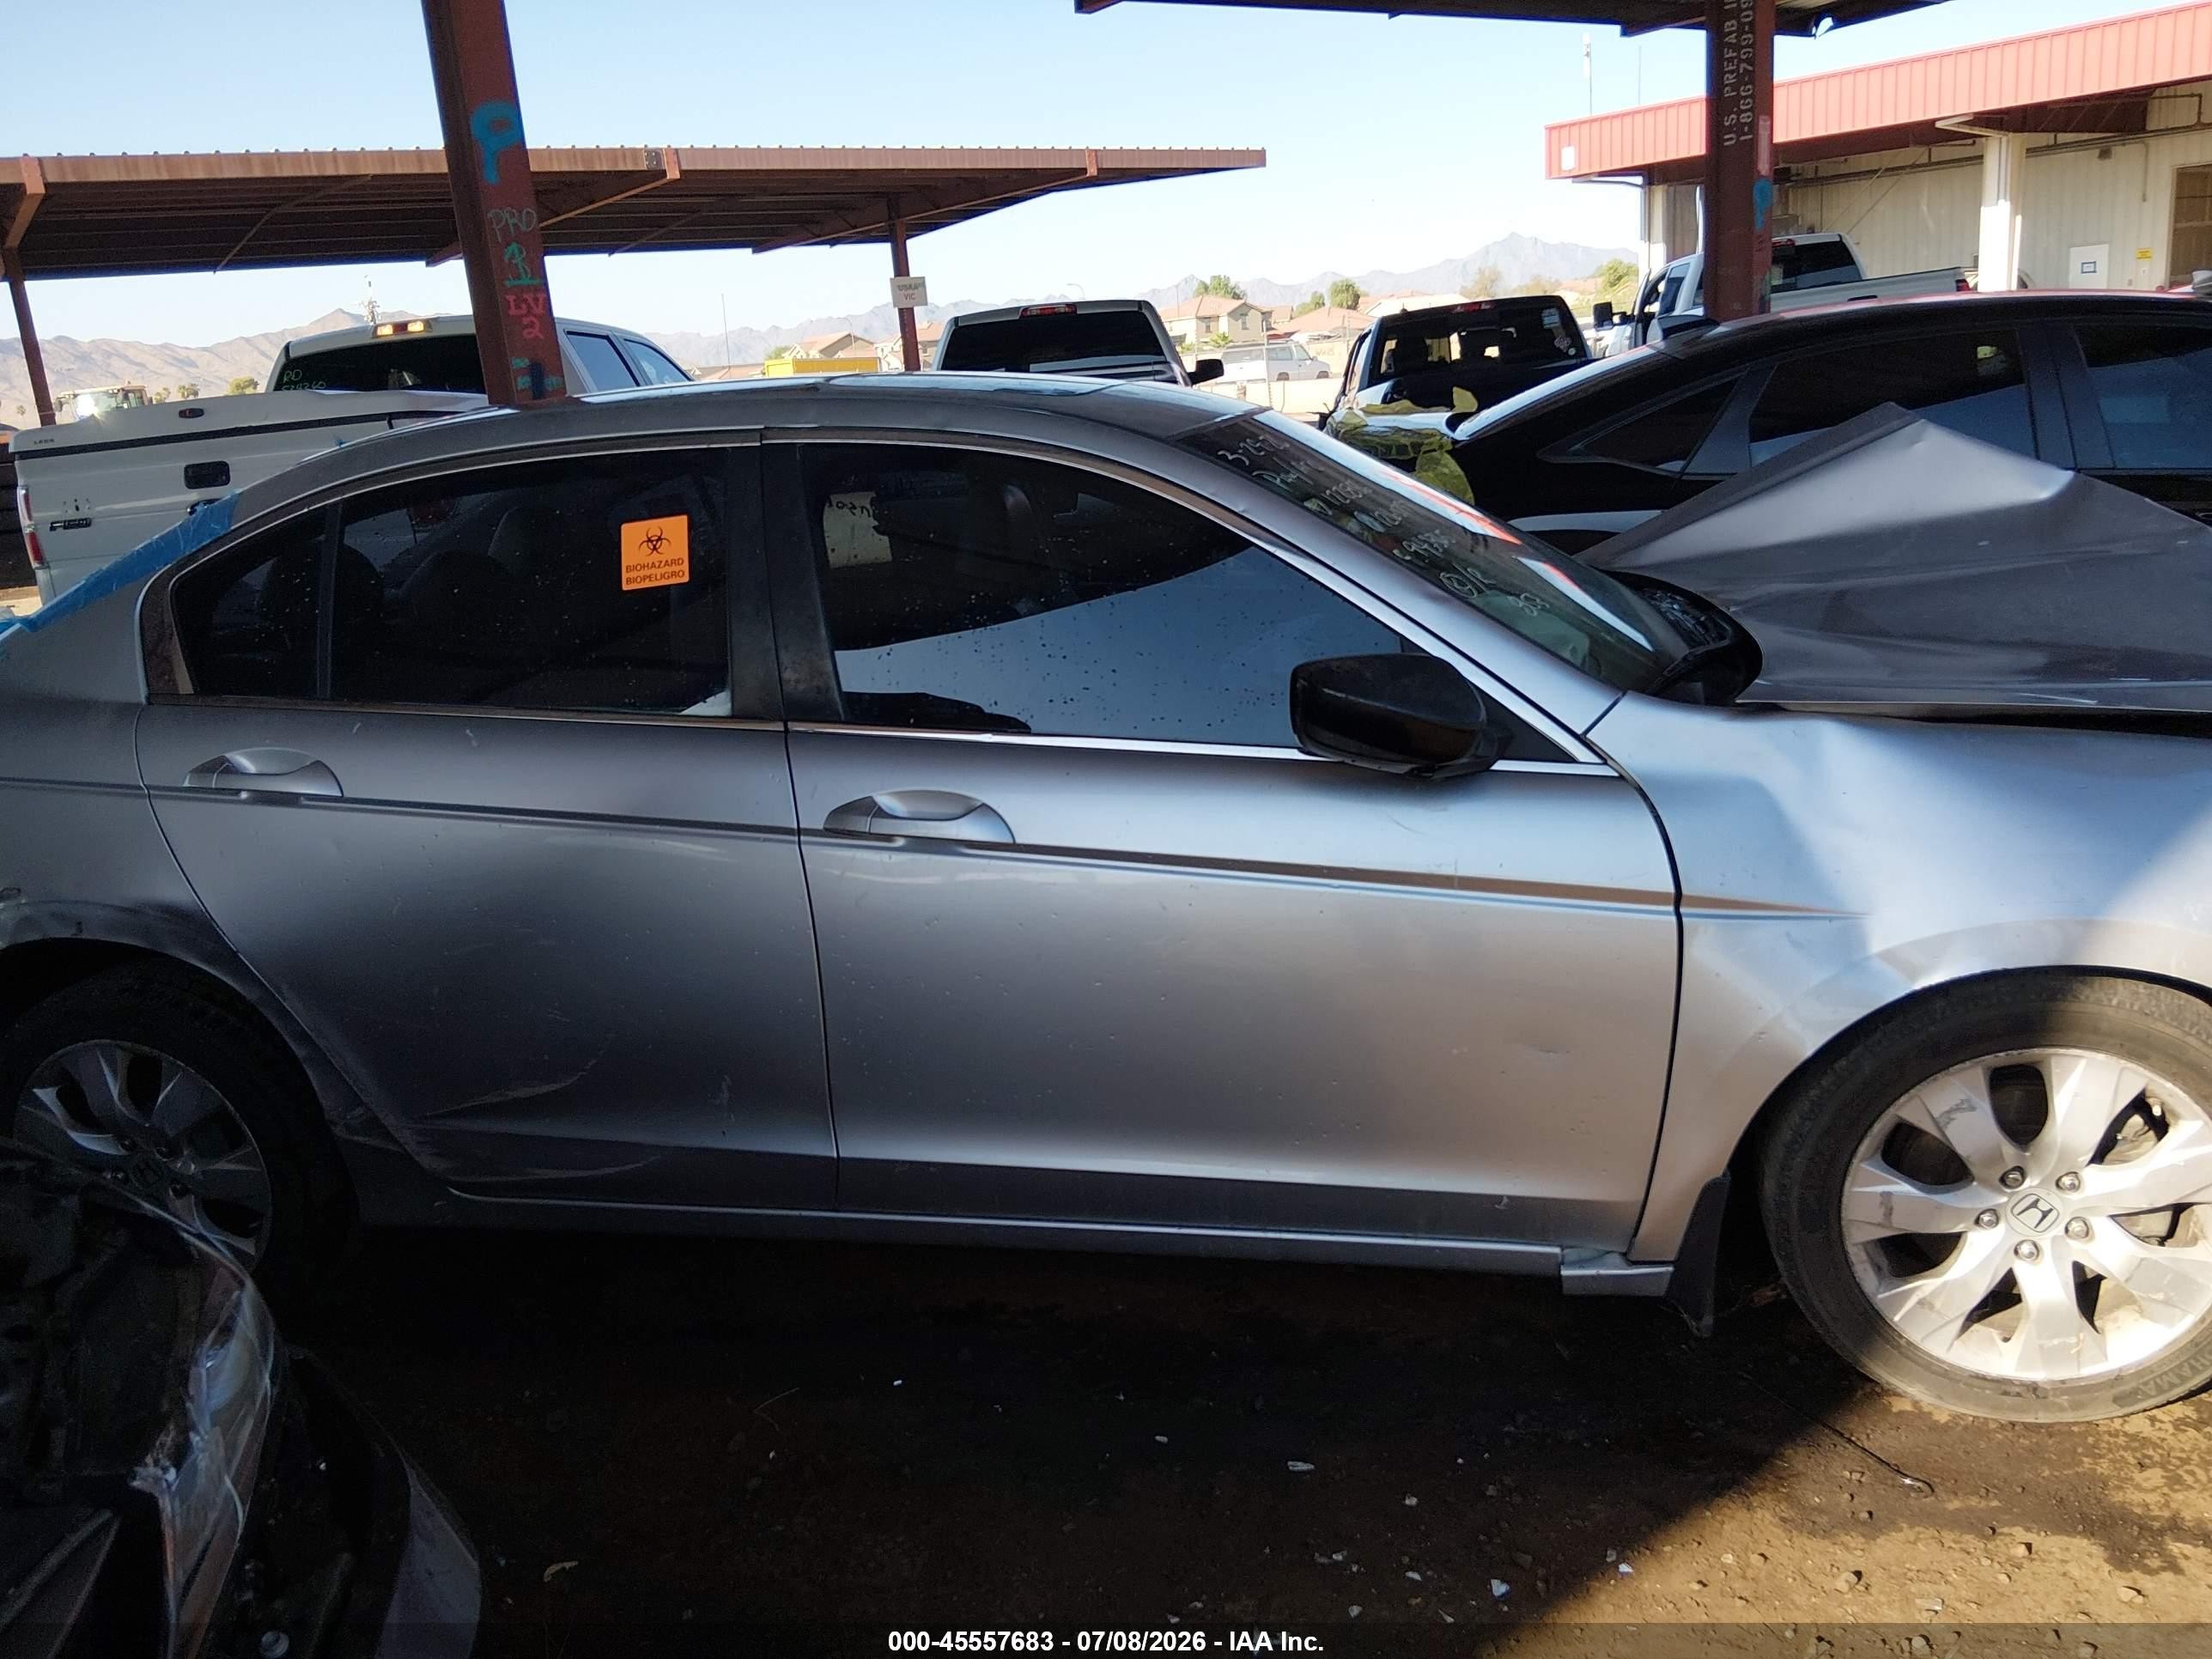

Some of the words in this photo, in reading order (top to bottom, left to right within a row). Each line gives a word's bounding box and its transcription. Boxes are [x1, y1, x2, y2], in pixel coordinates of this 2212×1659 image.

[1723, 20, 1738, 98] PREFAB
[625, 557, 684, 574] BIOHAZARD
[625, 569, 685, 586] BIOPELIGRO
